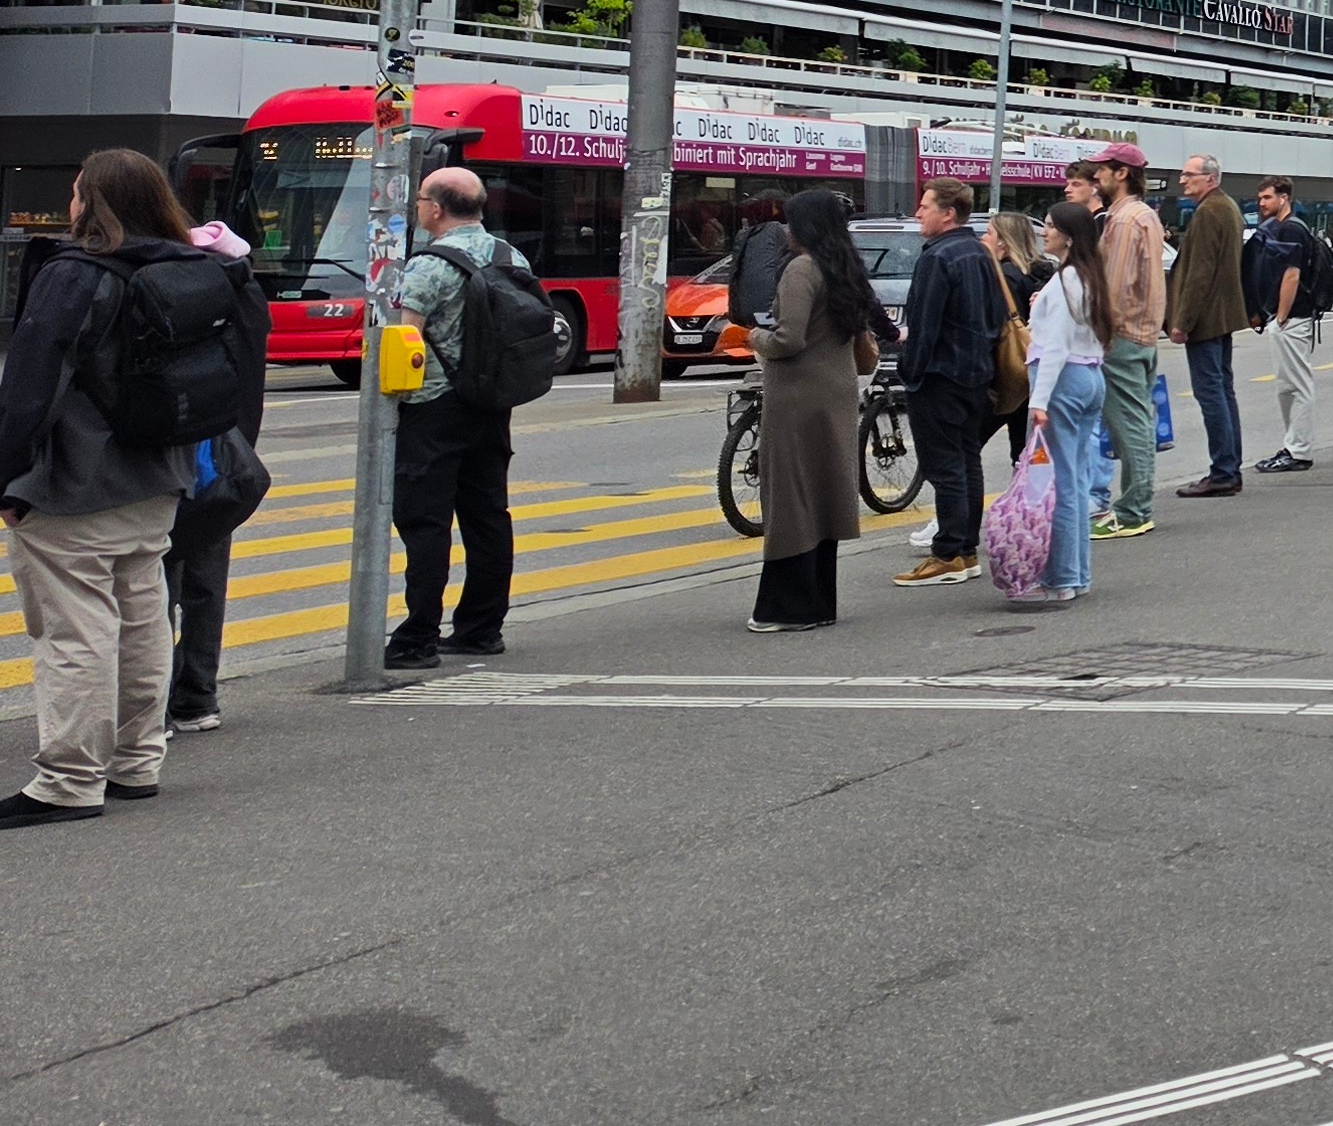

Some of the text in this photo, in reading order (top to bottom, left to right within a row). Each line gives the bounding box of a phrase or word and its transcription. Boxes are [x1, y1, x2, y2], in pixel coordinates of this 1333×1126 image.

[529, 98, 571, 129] Didac
[589, 104, 628, 133] Didac
[698, 114, 733, 140] Didac
[748, 118, 780, 143] Didac
[794, 121, 825, 146] Didac
[529, 133, 797, 172] 10./12. Schulj biniert mit Sprachjahr
[322, 303, 344, 318] 22
